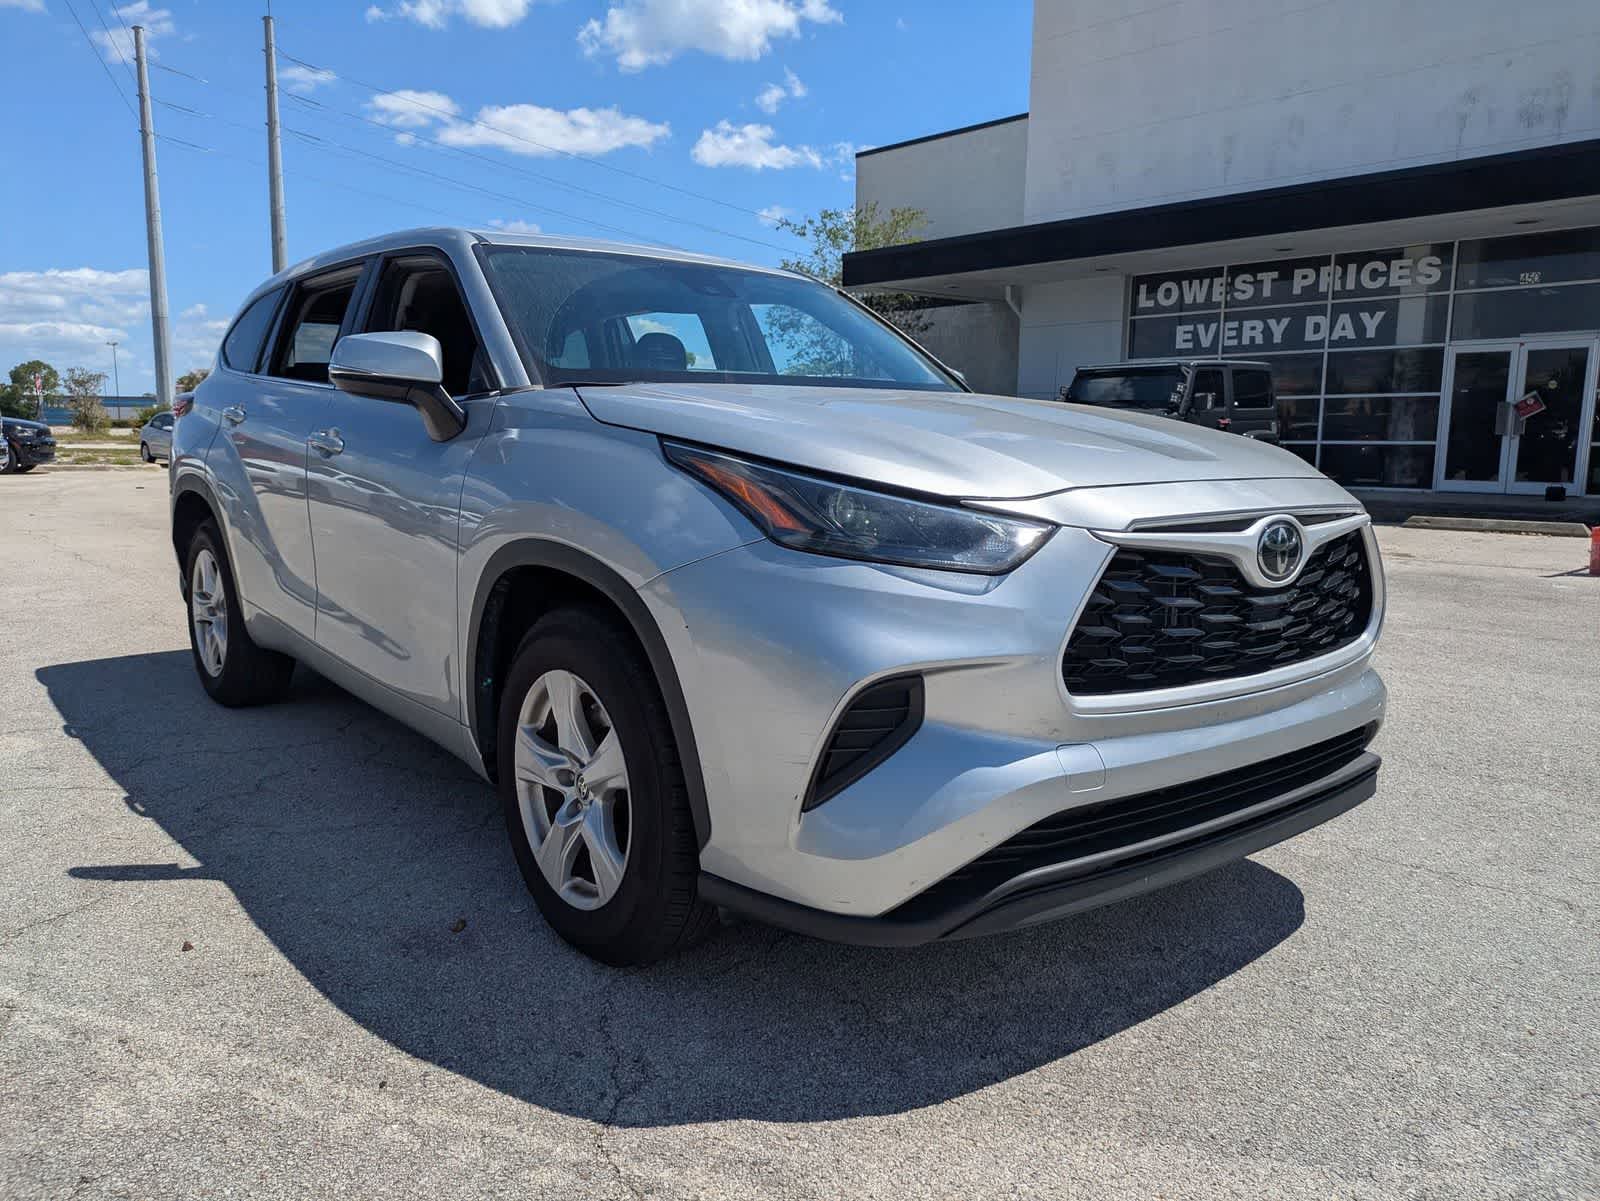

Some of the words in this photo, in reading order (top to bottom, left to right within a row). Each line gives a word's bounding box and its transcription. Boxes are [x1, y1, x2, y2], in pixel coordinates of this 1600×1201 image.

[1138, 271, 1279, 308] LOWEST
[1292, 256, 1442, 295] PRICES
[1175, 317, 1291, 349] EVERY
[1304, 311, 1387, 342] DAY
